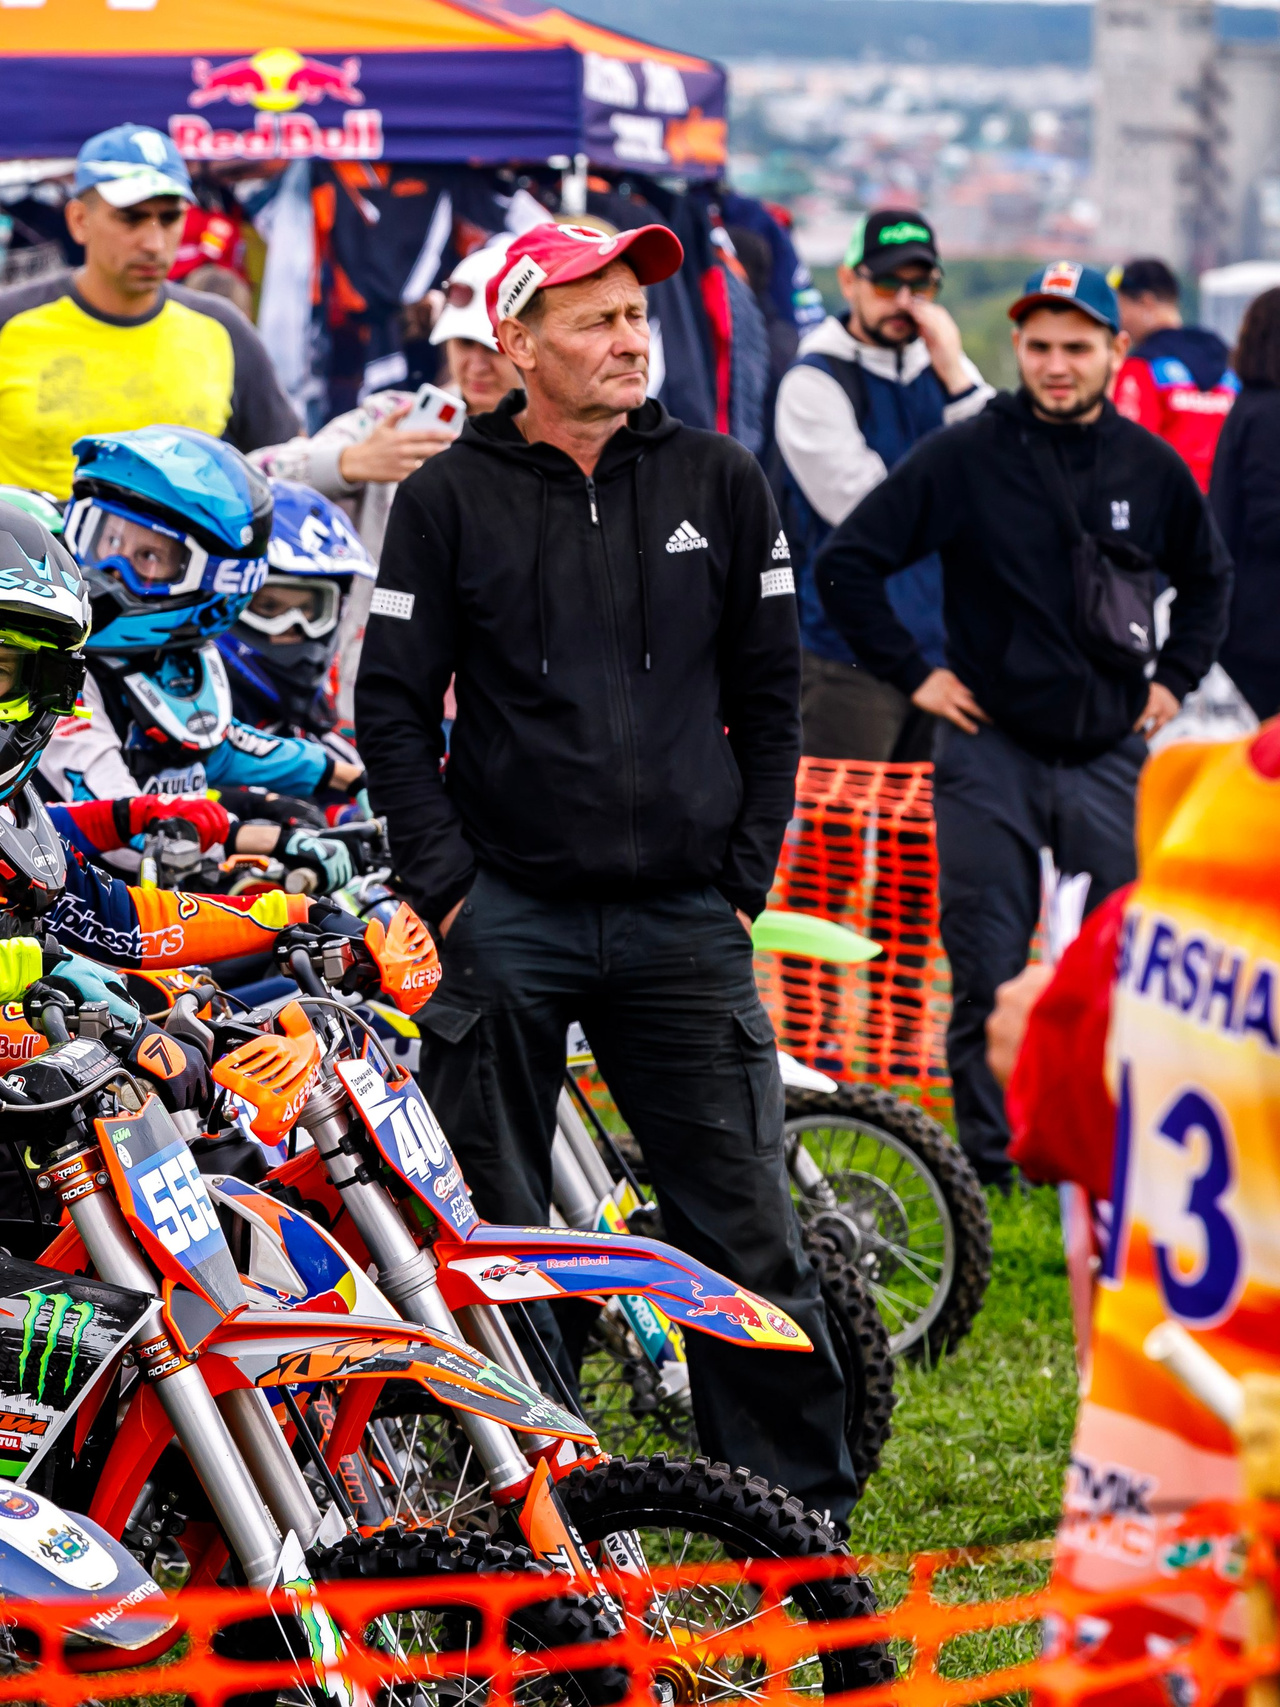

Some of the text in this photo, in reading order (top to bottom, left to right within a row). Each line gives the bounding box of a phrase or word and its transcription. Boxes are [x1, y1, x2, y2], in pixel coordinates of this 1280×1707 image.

[169, 109, 384, 161] Red Bull
[507, 269, 536, 307] YAMAHA
[665, 536, 709, 554] adidas
[112, 1127, 132, 1145] KTM
[50, 1161, 83, 1182] XTRIG
[62, 1180, 95, 1201] ROCS
[482, 1262, 539, 1280] IMS
[546, 1255, 610, 1269] Red Bull
[139, 1338, 169, 1358] XTRIG
[148, 1356, 181, 1378] ROCS
[255, 1337, 413, 1387] KTM
[89, 1579, 162, 1631] Husqvarna
